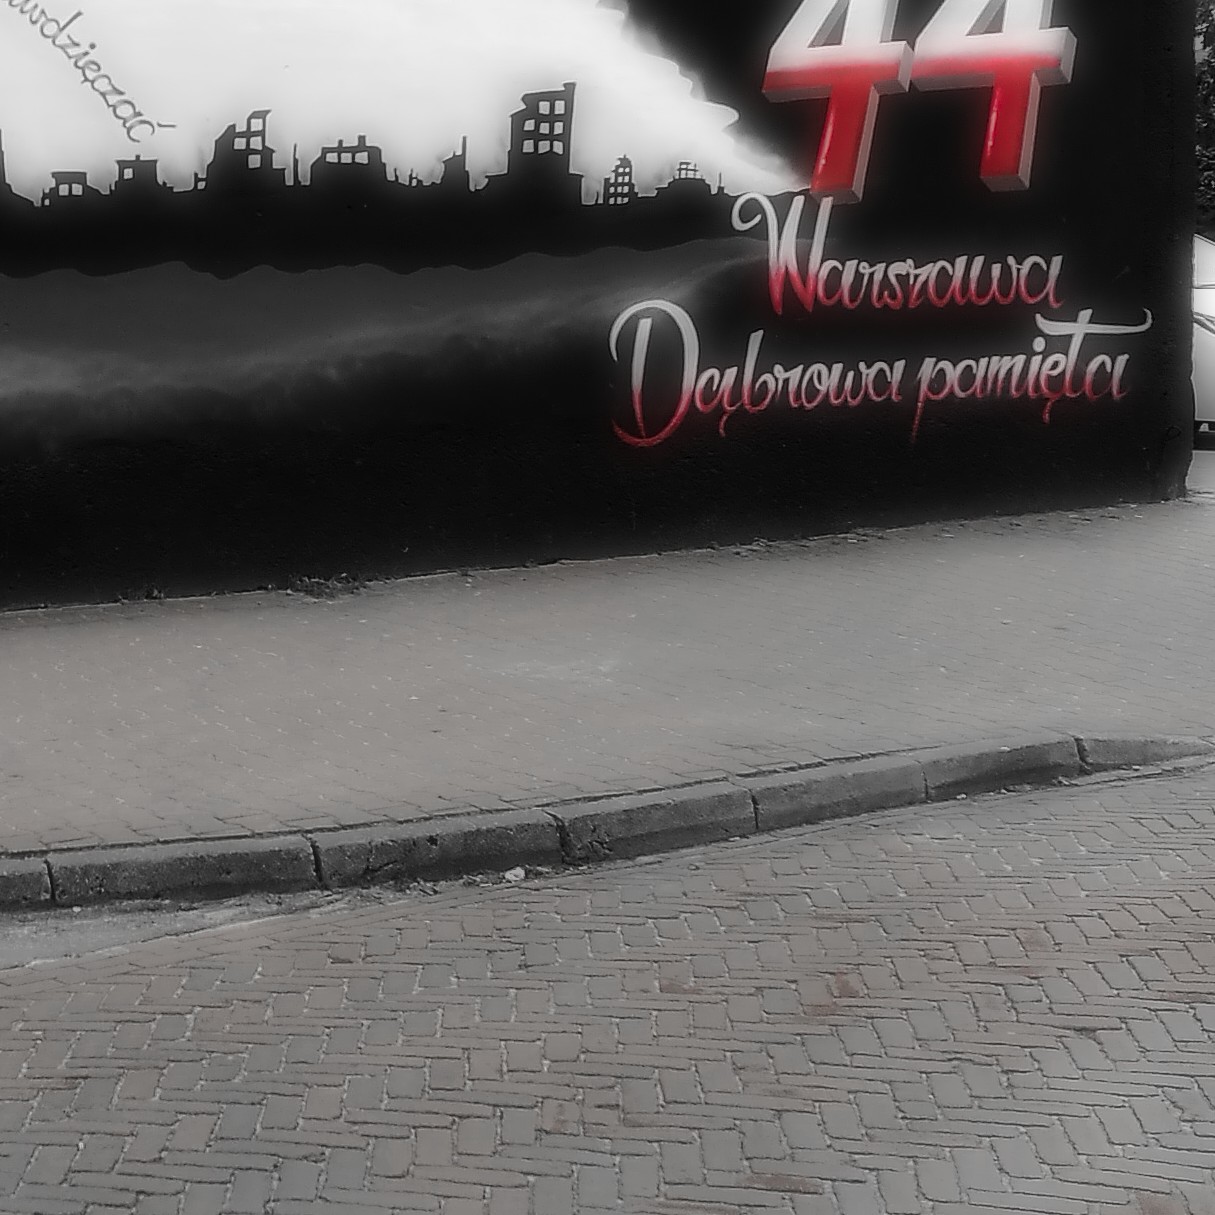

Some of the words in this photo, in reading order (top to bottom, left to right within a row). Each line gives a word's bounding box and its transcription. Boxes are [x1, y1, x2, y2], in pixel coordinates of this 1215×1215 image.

[730, 190, 1065, 315] Warszawa
[608, 299, 903, 448] Dąbrowa
[909, 307, 1155, 445] pamięta
